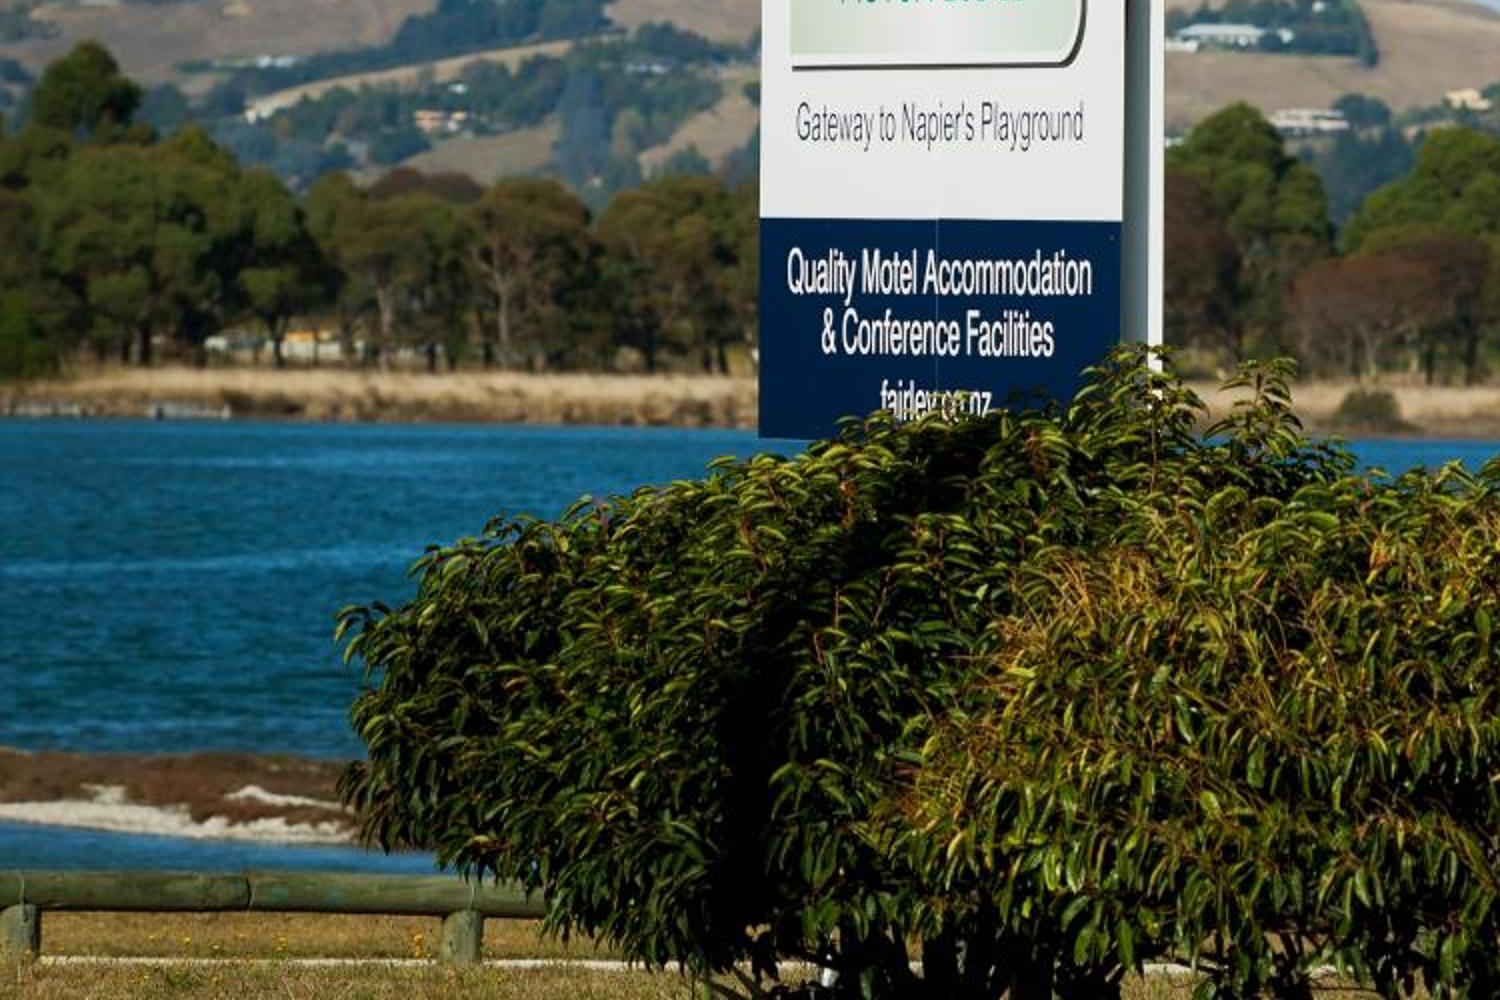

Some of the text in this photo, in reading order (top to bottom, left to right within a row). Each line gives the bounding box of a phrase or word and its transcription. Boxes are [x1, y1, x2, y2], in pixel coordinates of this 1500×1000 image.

[797, 101, 1085, 152] Gateway to Napier's Playground
[787, 247, 1092, 305] Quality Motel Accommodation
[821, 307, 1055, 357] & Conference Facilities
[880, 379, 992, 422] fairleyco.nz
